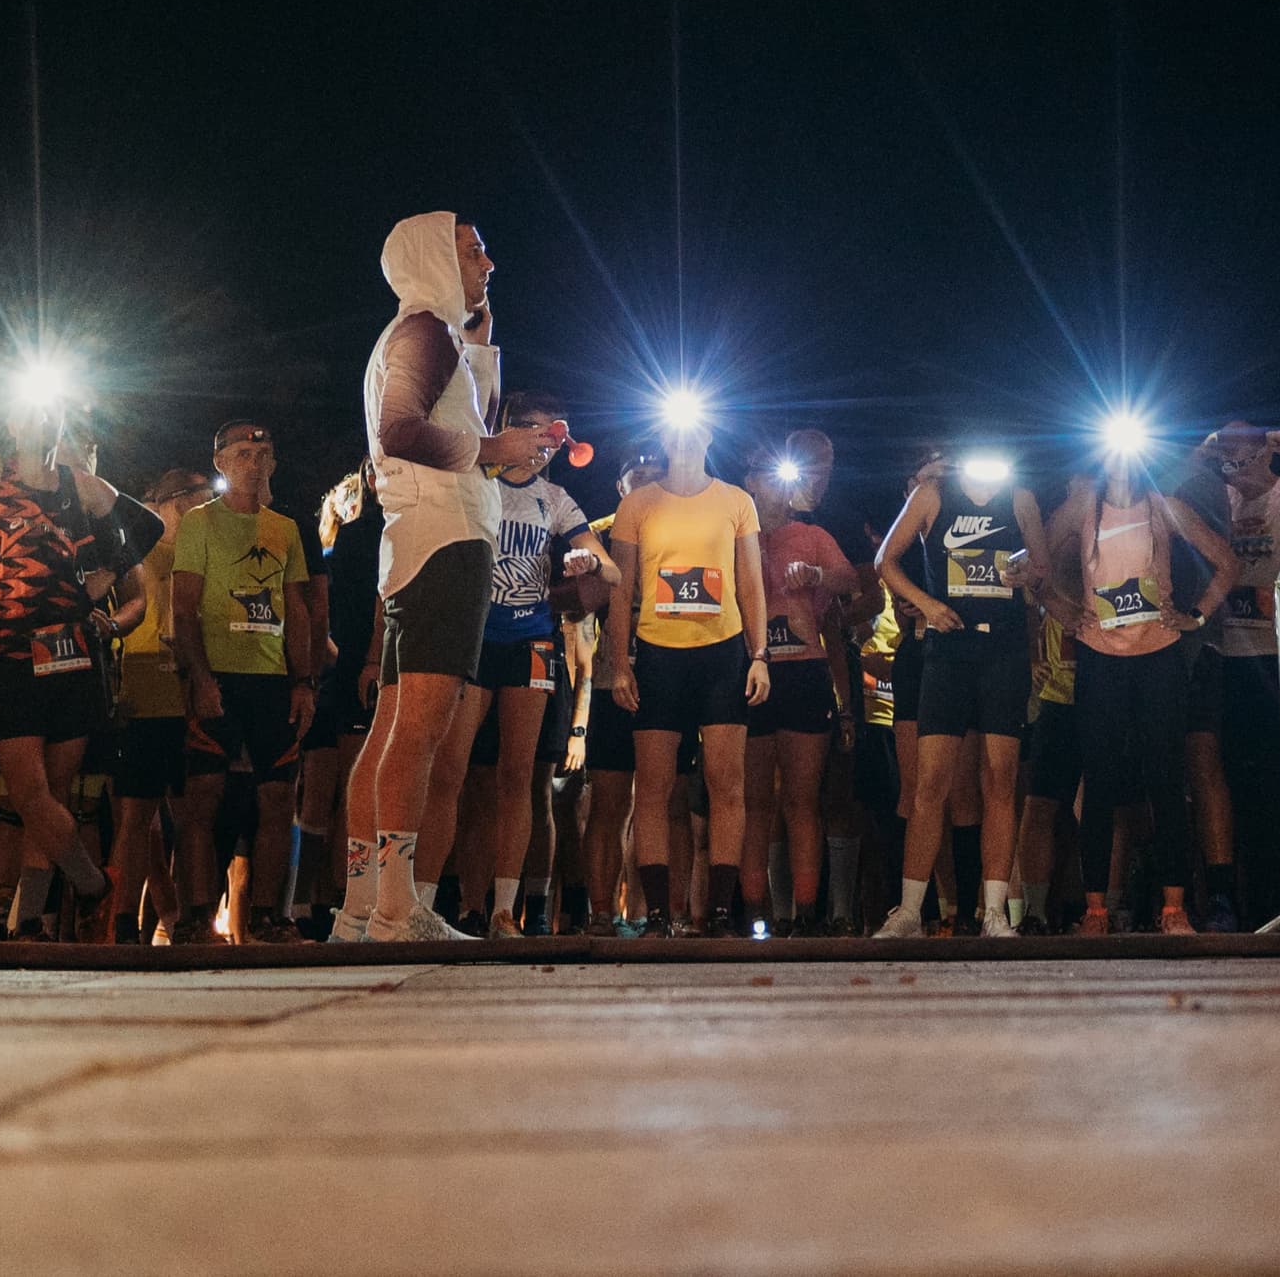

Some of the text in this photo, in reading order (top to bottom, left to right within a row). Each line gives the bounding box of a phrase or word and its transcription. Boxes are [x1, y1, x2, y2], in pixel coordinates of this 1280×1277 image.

[952, 515, 993, 536] NIKE
[496, 519, 550, 557] UNNE
[967, 564, 996, 583] 224
[678, 582, 699, 599] 45
[248, 602, 272, 620] 326
[1115, 592, 1143, 613] 223
[55, 638, 74, 657] 111
